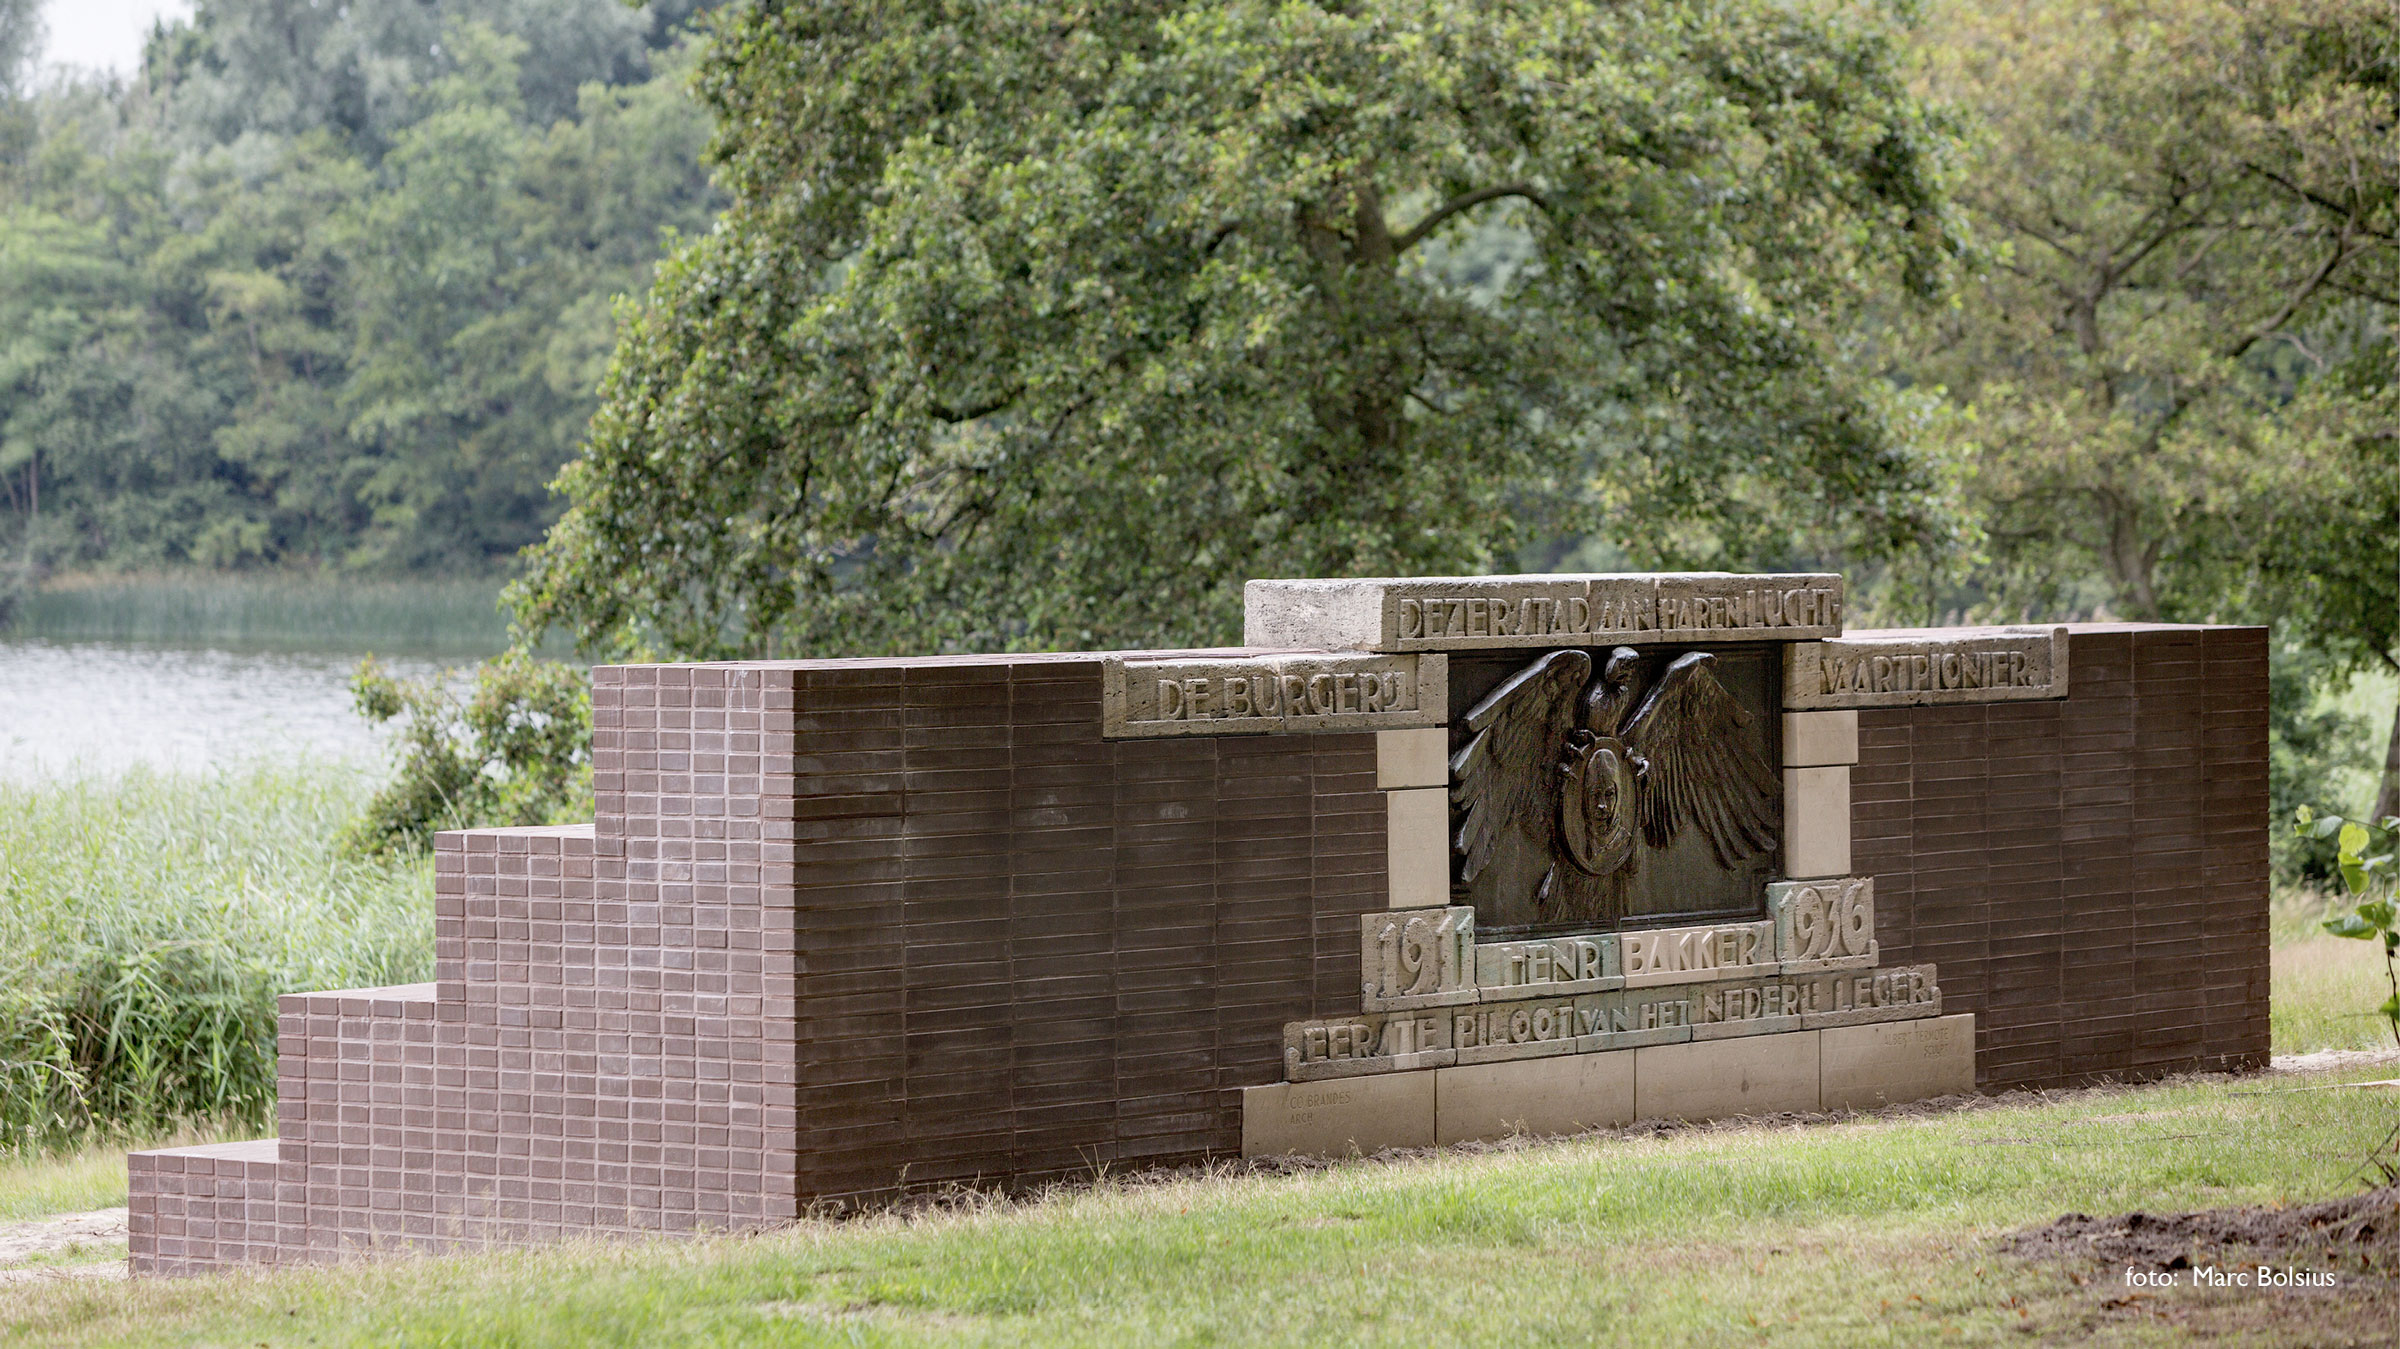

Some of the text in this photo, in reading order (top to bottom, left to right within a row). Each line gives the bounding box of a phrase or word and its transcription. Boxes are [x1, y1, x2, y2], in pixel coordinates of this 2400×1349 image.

[1599, 599, 1651, 632] AAN
[1659, 596, 1740, 631] HAREN
[1820, 650, 2030, 695] VAARTPIONIER
[1158, 677, 1211, 721] DE
[1777, 883, 1869, 962] 1936
[1376, 912, 1475, 1001] 1911
[1501, 927, 1759, 985] HENRI BAKKER
[1303, 1018, 1438, 1062] EERSTE
[1455, 1006, 1574, 1048] PILOOT
[1579, 1006, 1629, 1035] VAN
[1640, 1000, 1689, 1030] HET
[1307, 1091, 1351, 1108] BRANDES
